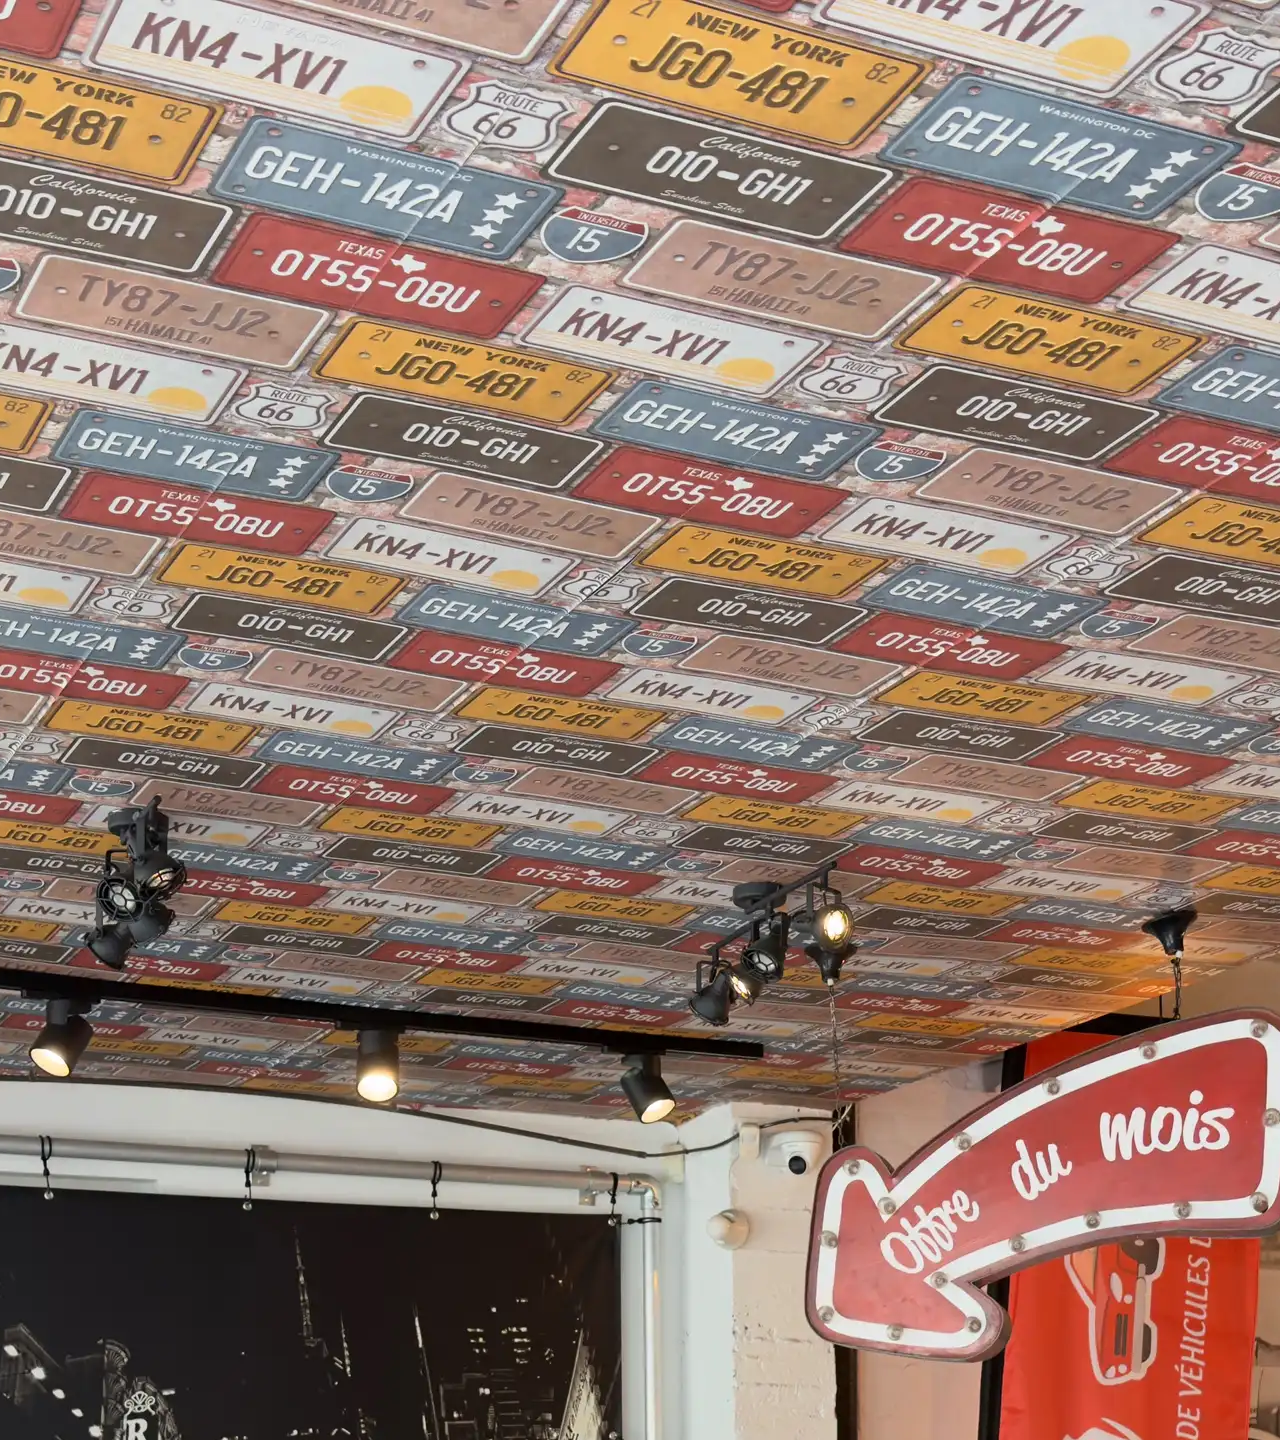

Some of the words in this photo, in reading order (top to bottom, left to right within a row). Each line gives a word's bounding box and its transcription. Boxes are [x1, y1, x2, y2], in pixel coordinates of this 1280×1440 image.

[1212, 40, 1266, 62] ROUTE
[1176, 61, 1235, 90] 66
[29, 174, 140, 204] California
[241, 145, 467, 223] GEH-142A
[1217, 183, 1269, 210] 15
[977, 201, 1035, 223] TEXAS
[563, 226, 612, 252] 15
[365, 329, 394, 343] 21
[553, 307, 734, 366] KN4-XV1
[411, 337, 477, 356] NEW
[486, 350, 556, 373] YORK
[564, 369, 596, 384] 82
[2, 400, 31, 414] 82
[269, 390, 313, 404] ROUTE
[256, 403, 296, 421] 66
[618, 399, 803, 454] GEH-142A
[74, 426, 260, 478] GEH-142A
[1225, 436, 1270, 451] TEXAS
[680, 466, 726, 481] TEXAS
[159, 488, 204, 503] TEXAS
[855, 512, 994, 553] KN4-XV1
[350, 532, 502, 574] KN4-XV1
[842, 788, 948, 812] KN4-XV1
[880, 1188, 980, 1275] Offre
[1011, 1139, 1073, 1201] du
[1100, 1090, 1235, 1162] mois
[1174, 1263, 1211, 1397] VÉHICULES
[1175, 1403, 1201, 1440] DE
